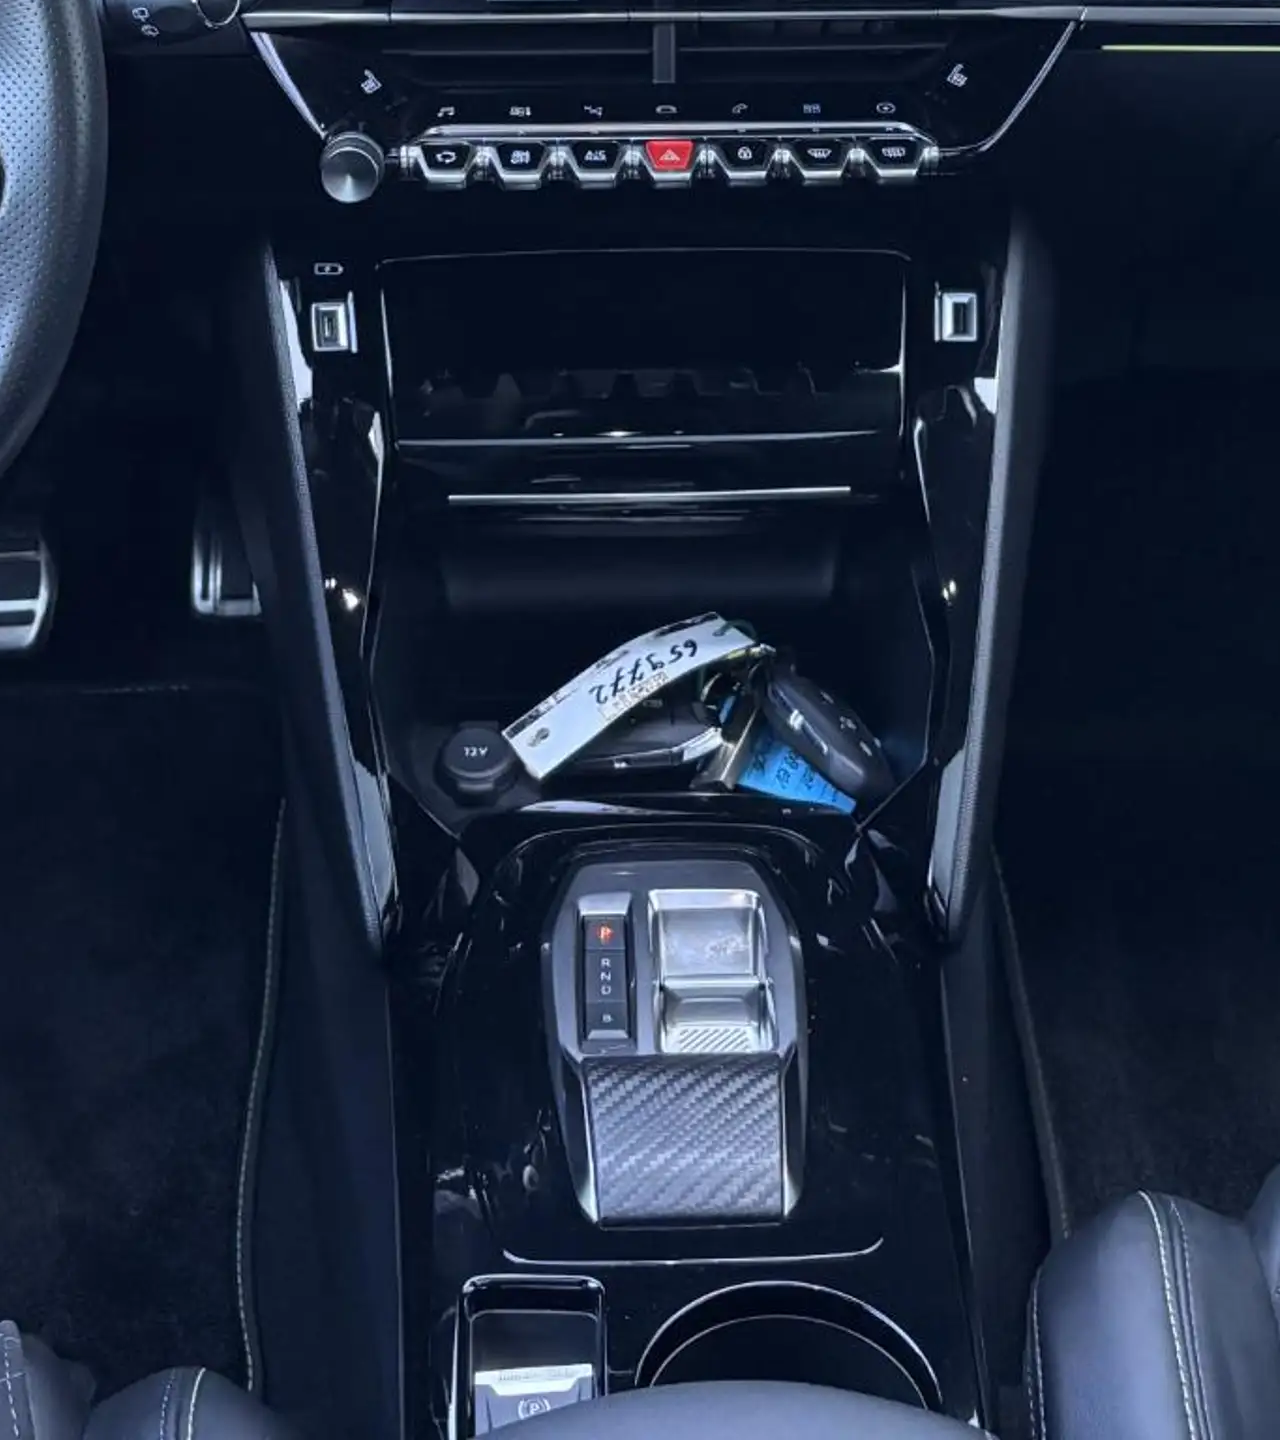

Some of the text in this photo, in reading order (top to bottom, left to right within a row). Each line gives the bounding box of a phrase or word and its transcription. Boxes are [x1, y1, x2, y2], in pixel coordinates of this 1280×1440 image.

[601, 958, 611, 968] R
[600, 971, 612, 982] N
[600, 985, 612, 995] D
